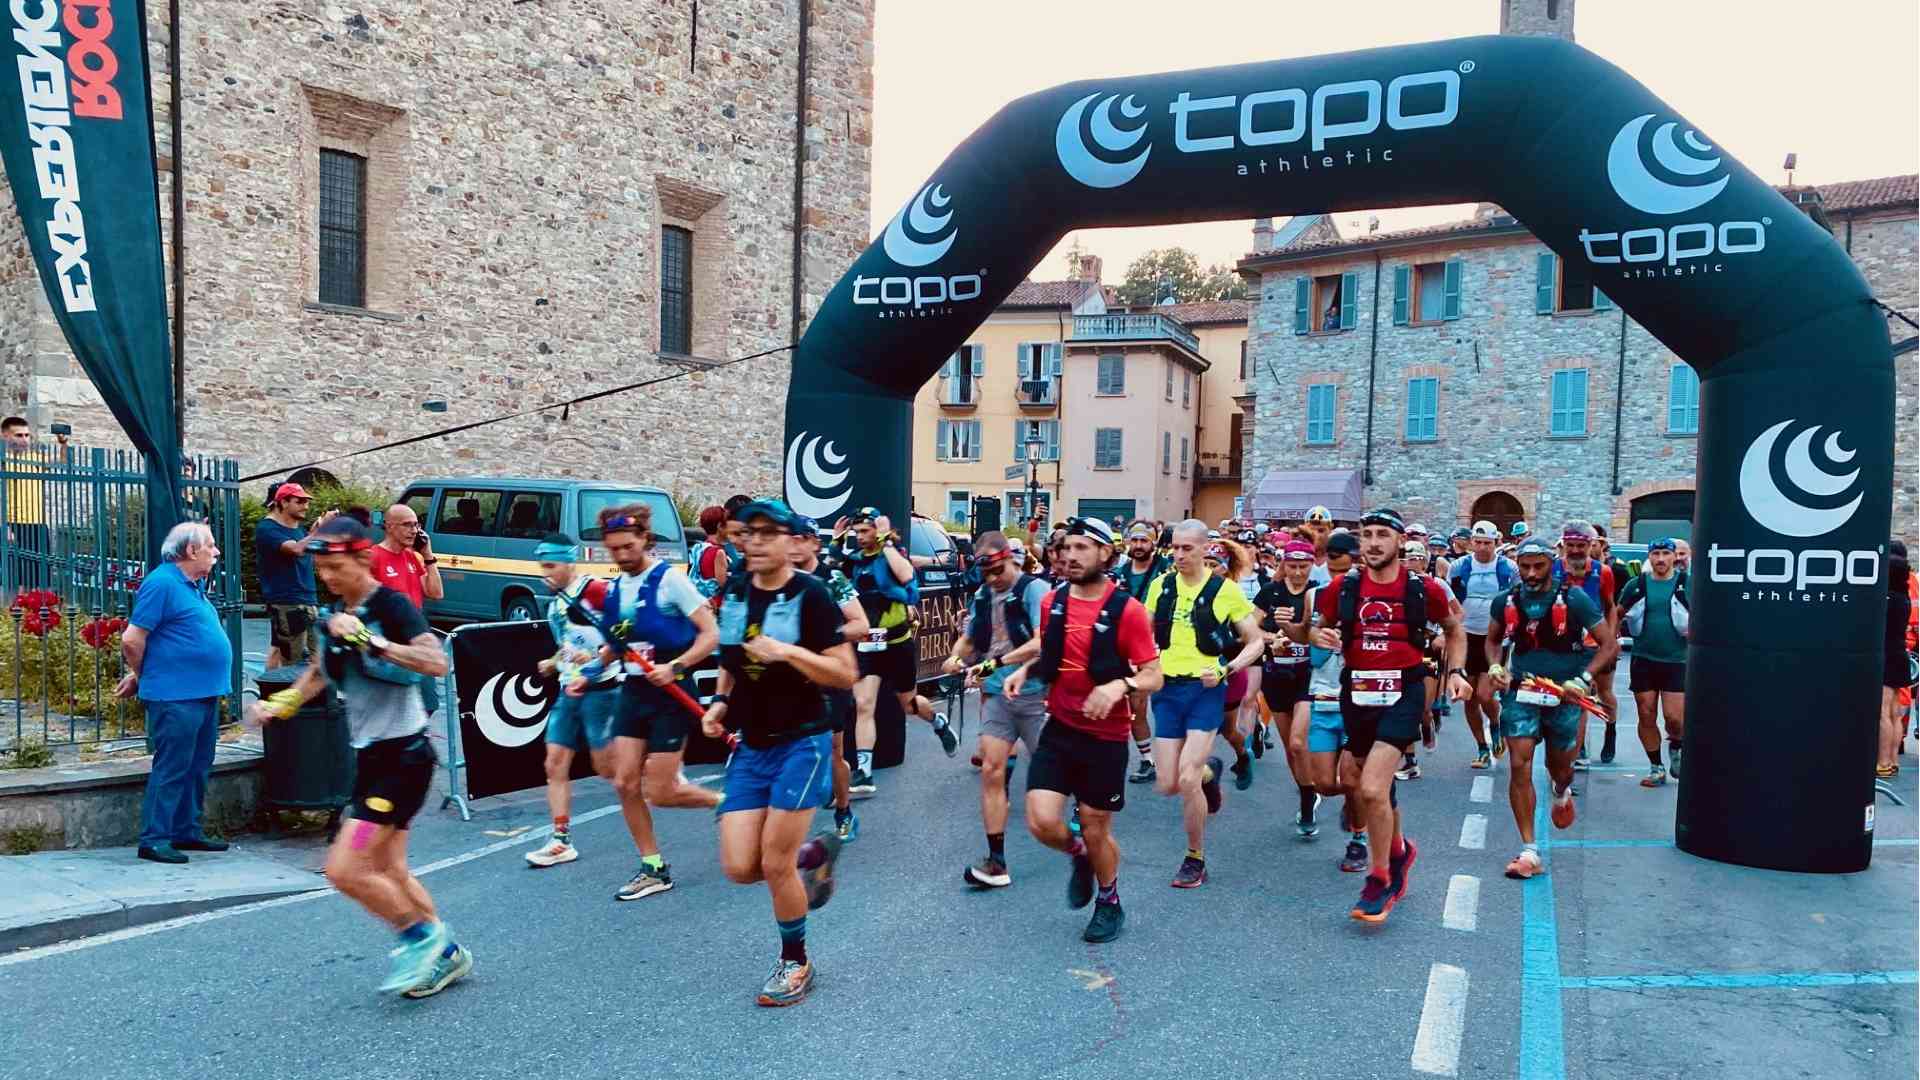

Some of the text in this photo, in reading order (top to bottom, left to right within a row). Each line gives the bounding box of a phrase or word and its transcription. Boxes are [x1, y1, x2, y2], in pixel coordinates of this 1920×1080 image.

[1236, 148, 1394, 176] athletic
[1623, 263, 1723, 279] athletic
[878, 307, 953, 318] athletic
[1741, 590, 1850, 602] athletic
[1290, 646, 1305, 657] 39
[1376, 679, 1395, 691] 73
